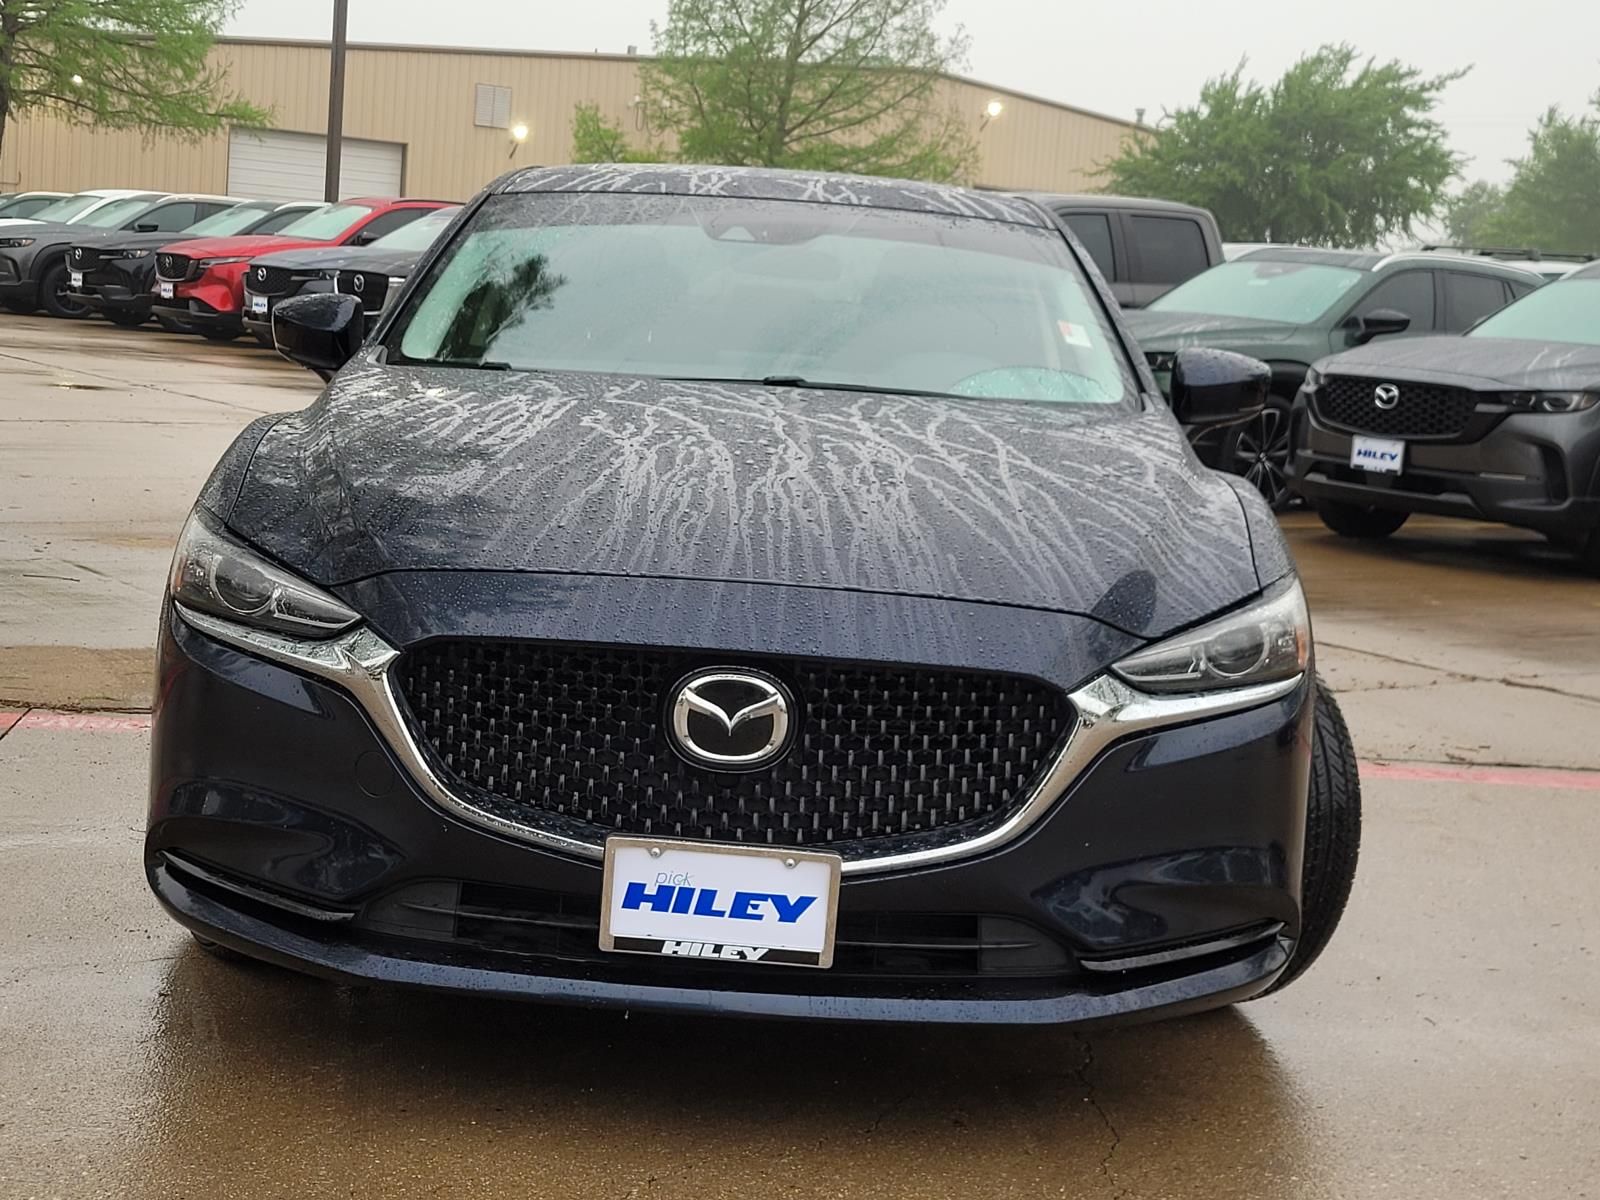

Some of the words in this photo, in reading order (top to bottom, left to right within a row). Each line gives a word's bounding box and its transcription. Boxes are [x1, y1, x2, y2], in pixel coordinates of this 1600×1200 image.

[654, 870, 695, 887] pick
[621, 881, 818, 924] HILEY
[661, 940, 769, 961] HILEY
